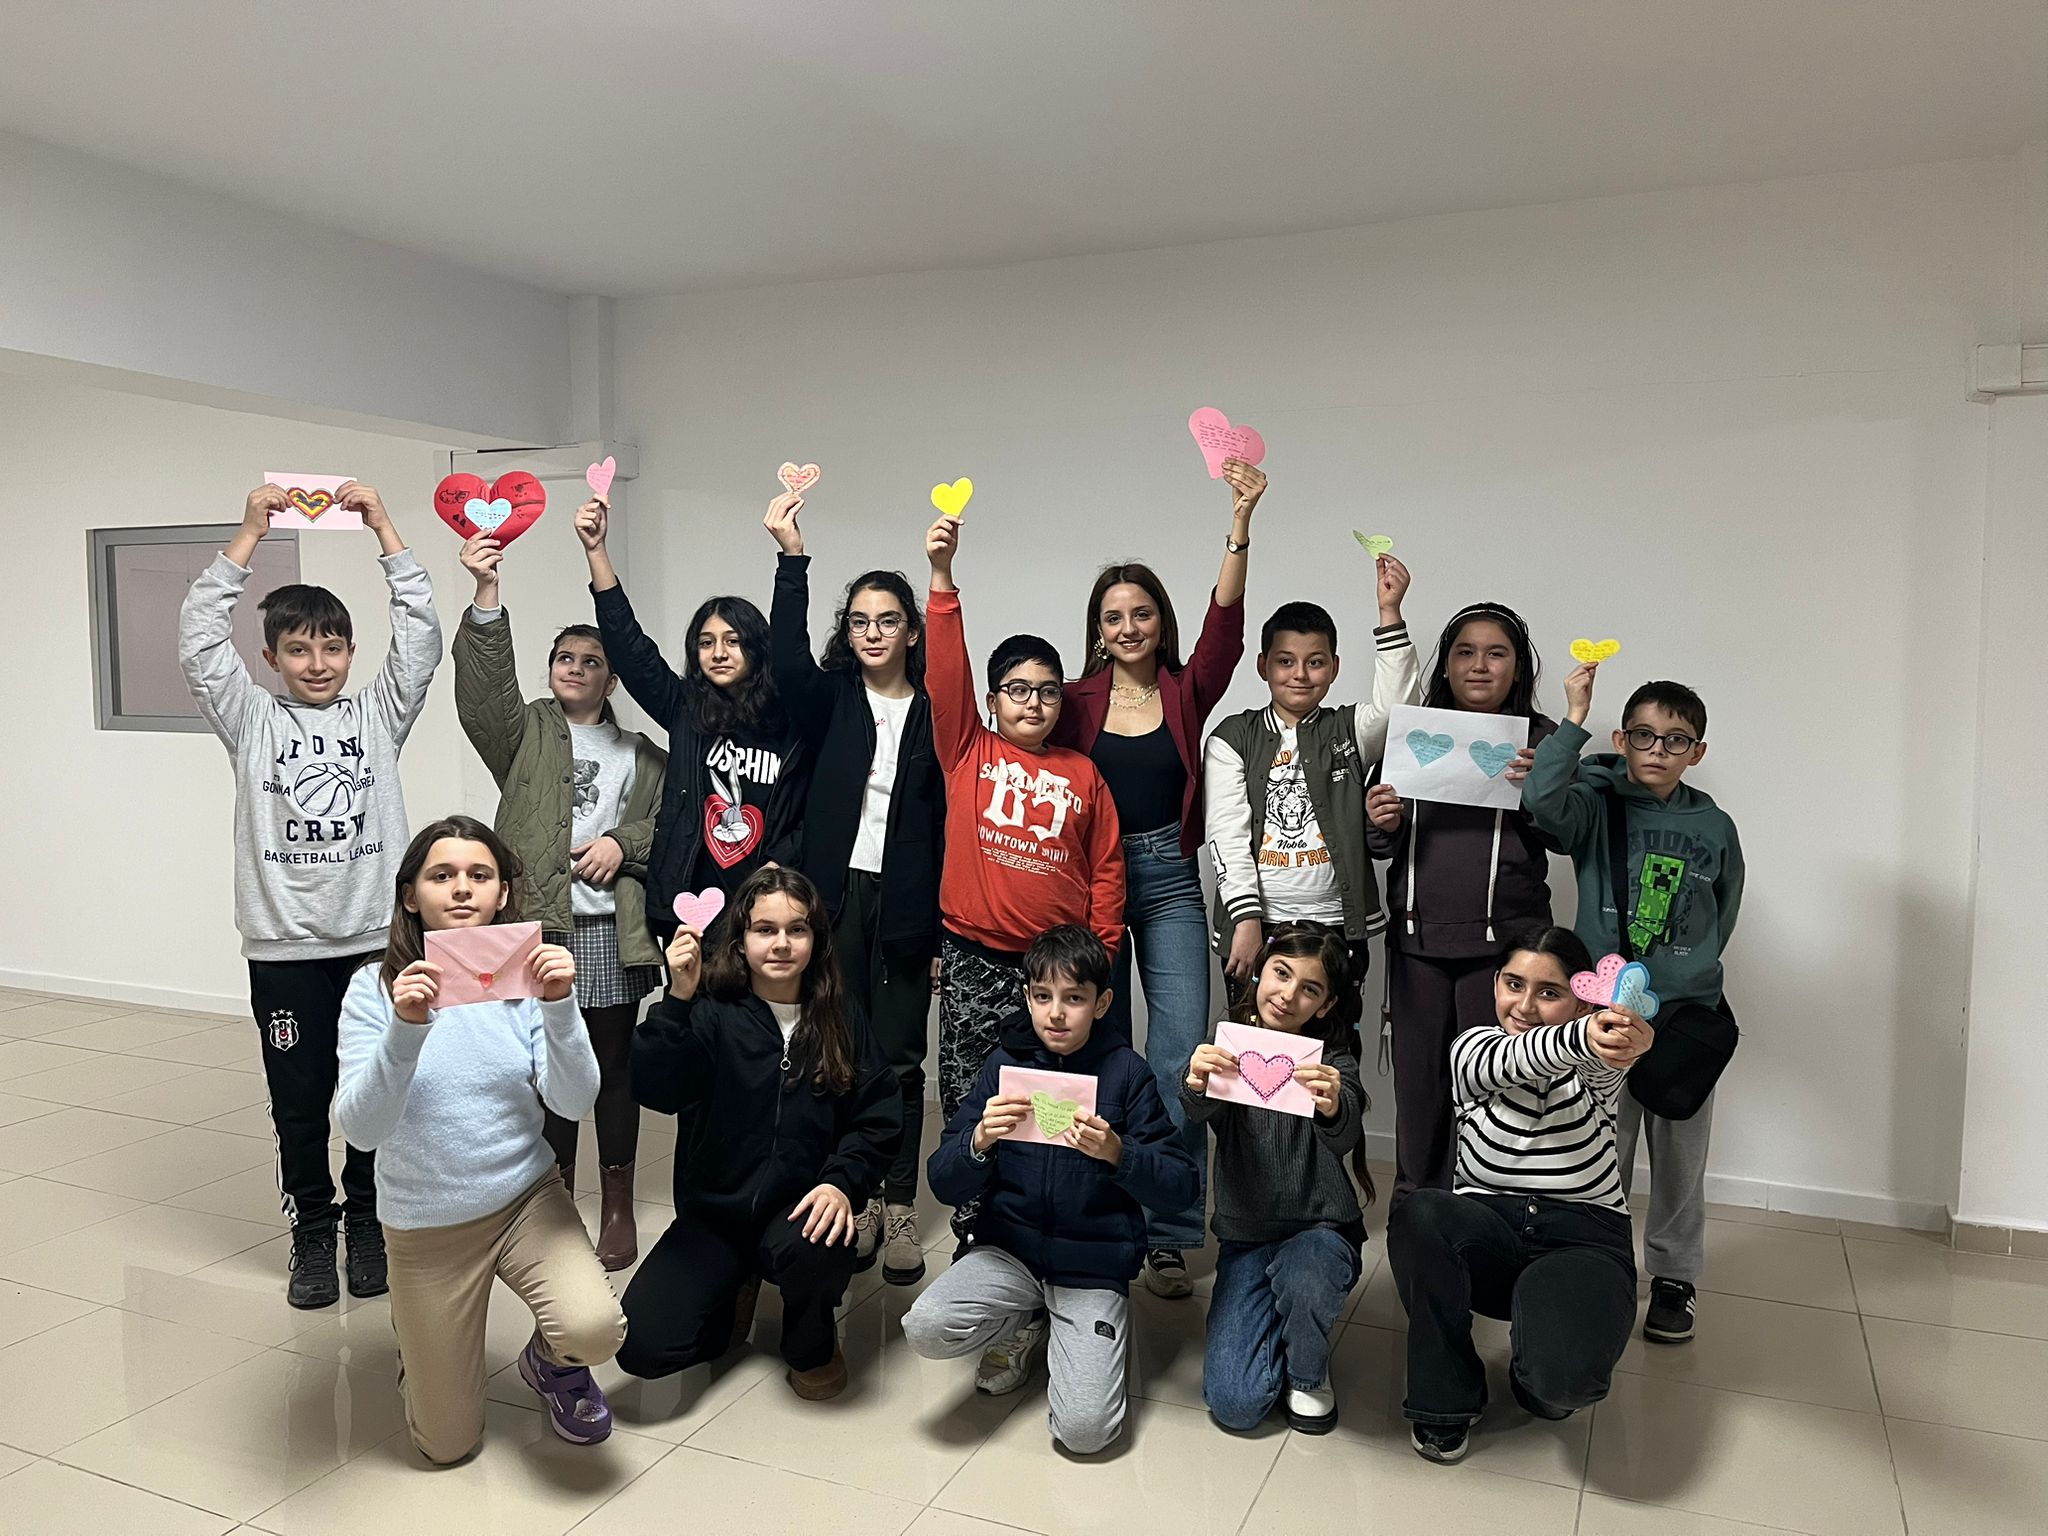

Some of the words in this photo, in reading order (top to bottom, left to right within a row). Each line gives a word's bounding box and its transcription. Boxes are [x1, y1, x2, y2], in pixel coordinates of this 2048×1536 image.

[286, 811, 366, 842] CREW
[264, 849, 345, 864] BASKETBALL
[349, 840, 384, 861] LEAGUE
[1257, 848, 1290, 868] ORN
[1295, 846, 1331, 868] FRE
